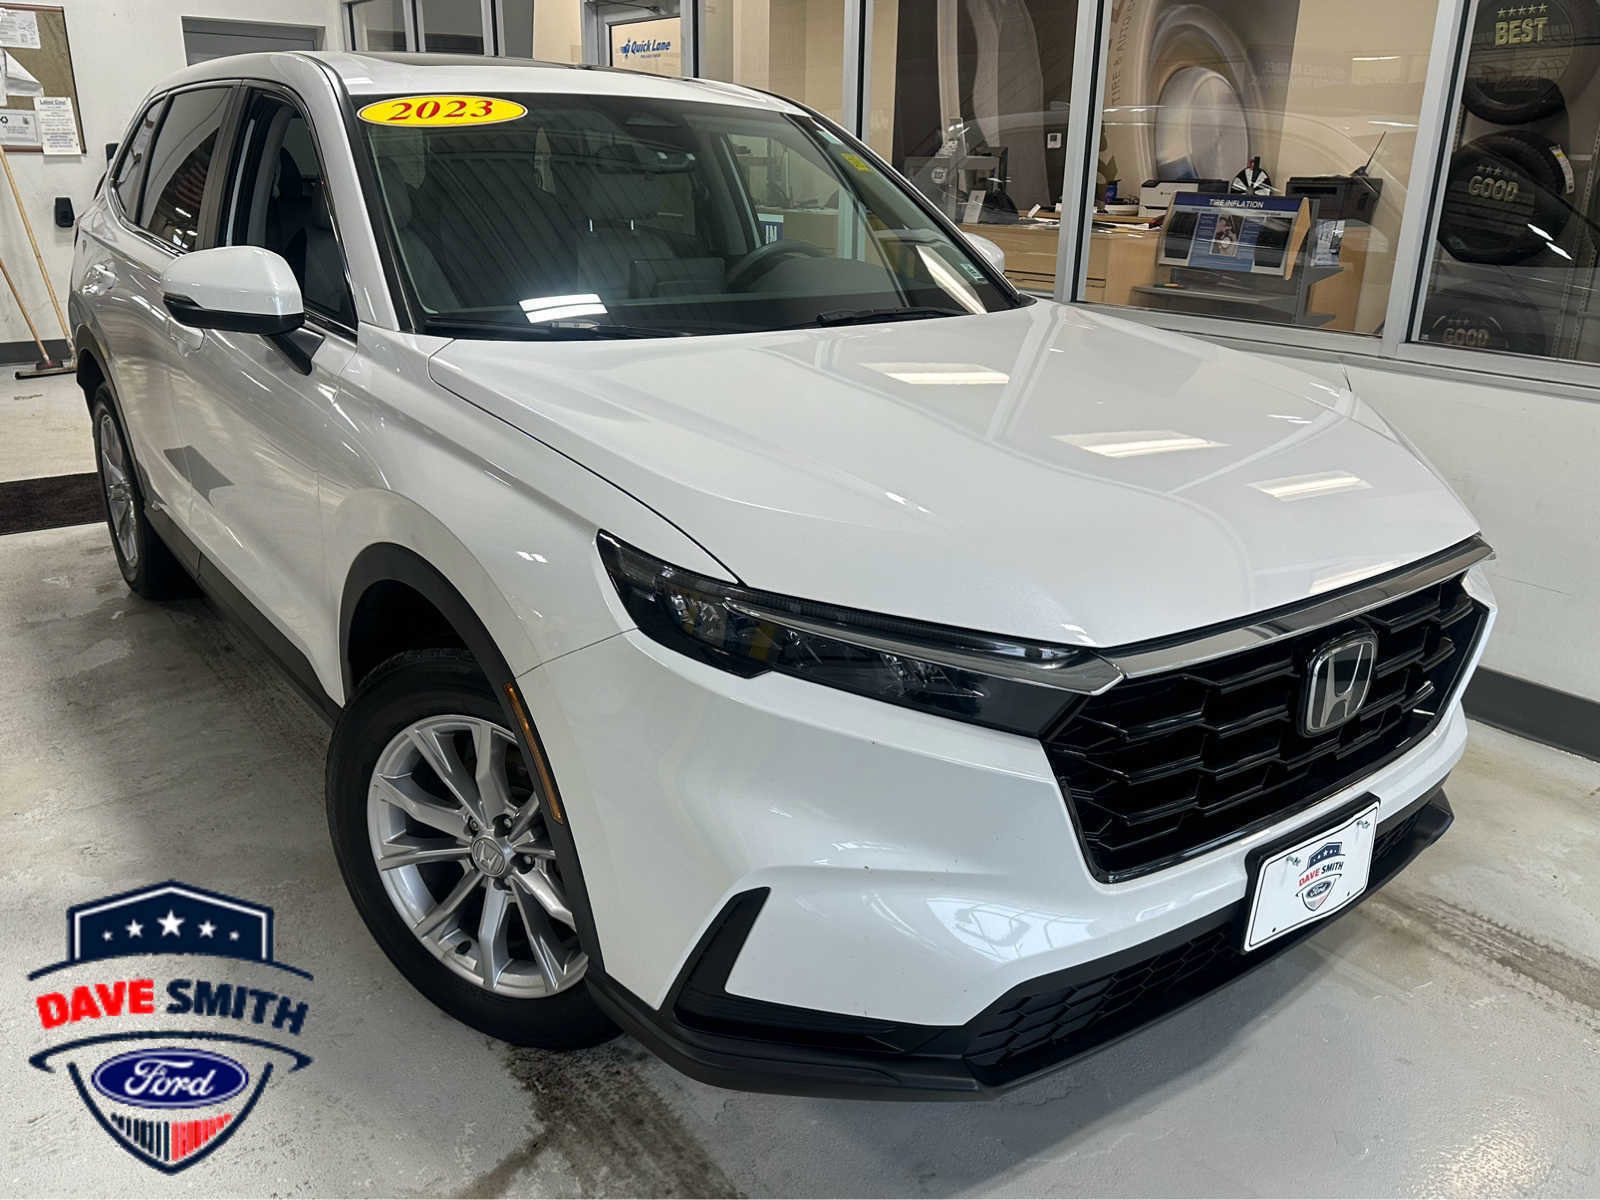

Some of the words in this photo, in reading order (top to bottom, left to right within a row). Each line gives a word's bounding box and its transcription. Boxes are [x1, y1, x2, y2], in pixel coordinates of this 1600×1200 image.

[1495, 16, 1549, 46] BEST
[631, 39, 651, 54] Quick
[652, 39, 671, 52] Lane
[1111, 70, 1121, 106] TIRE
[386, 100, 493, 121] 2023
[1468, 175, 1519, 202] GOOD
[1225, 199, 1264, 209] INFLATION
[1443, 327, 1489, 347] GOOD
[1298, 867, 1320, 887] DAVE
[1321, 861, 1344, 875] SMITH
